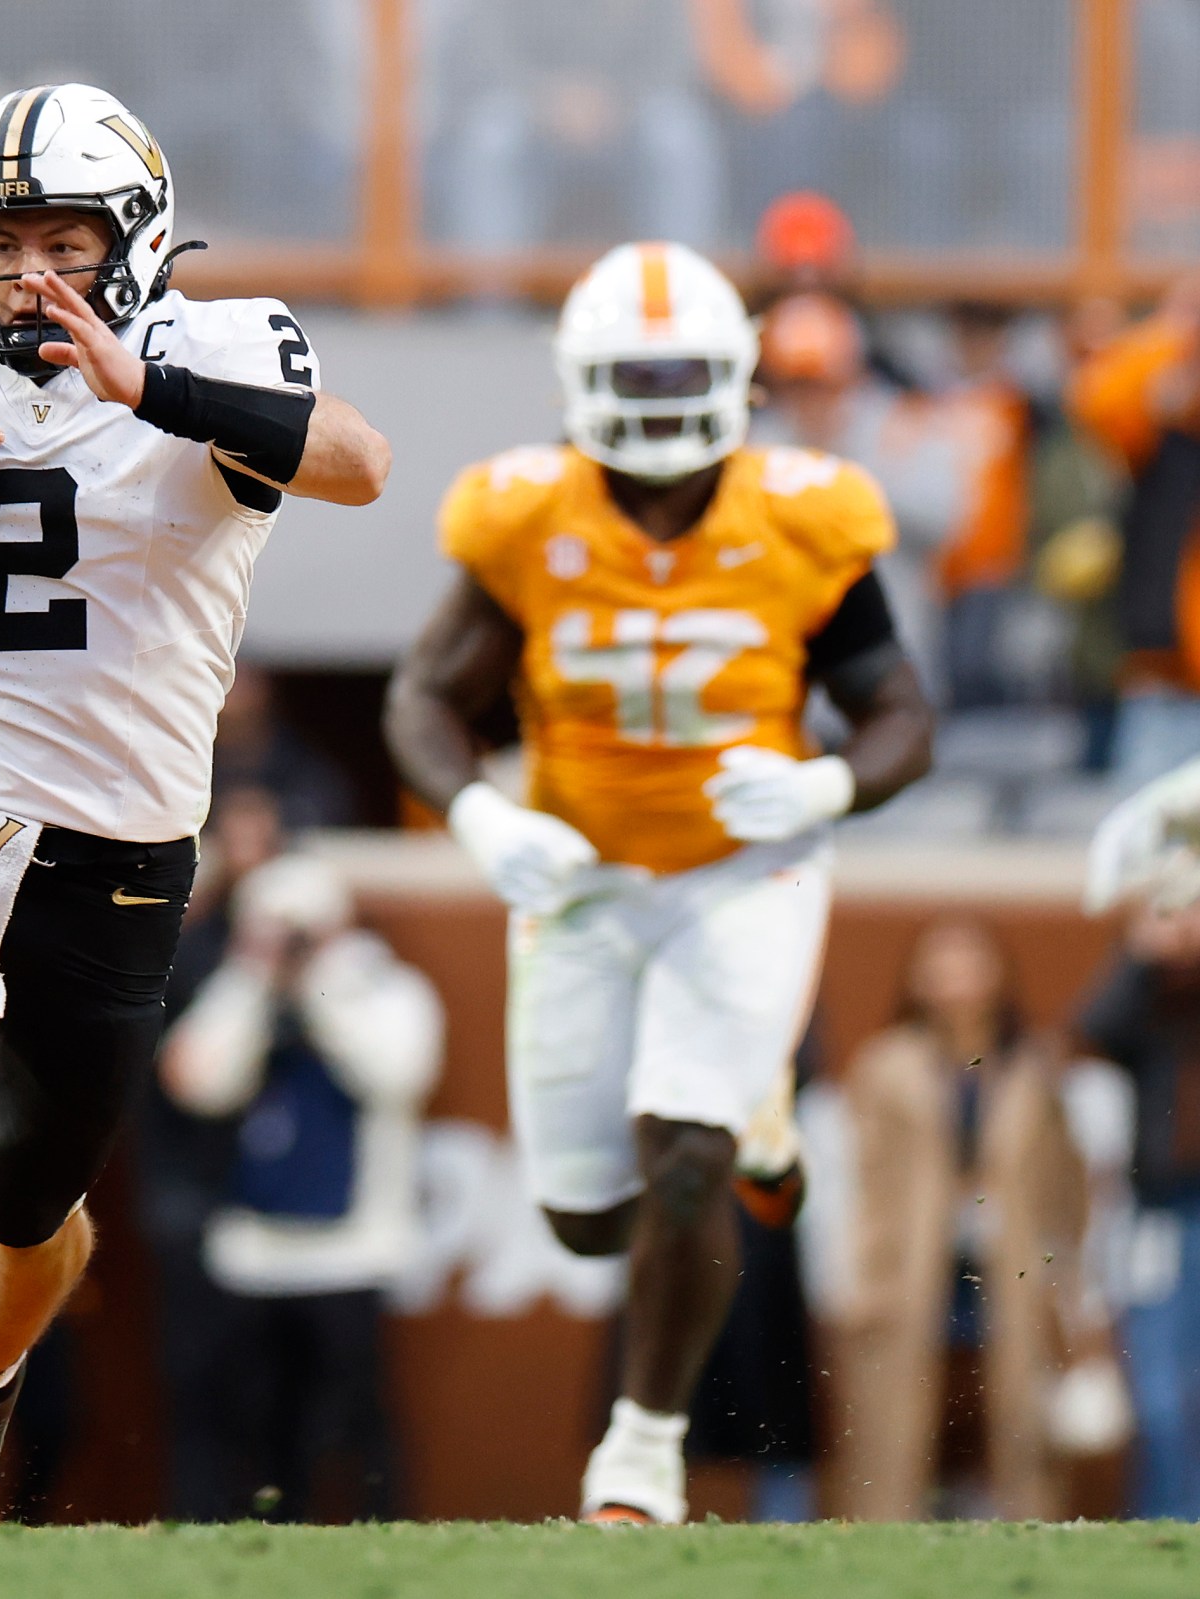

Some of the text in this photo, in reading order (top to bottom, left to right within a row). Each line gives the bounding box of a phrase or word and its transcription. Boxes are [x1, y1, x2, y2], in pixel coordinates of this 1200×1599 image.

[95, 111, 165, 181] V
[139, 319, 175, 362] C
[268, 314, 312, 387] 2
[32, 404, 51, 424] V
[550, 608, 770, 748] 42
